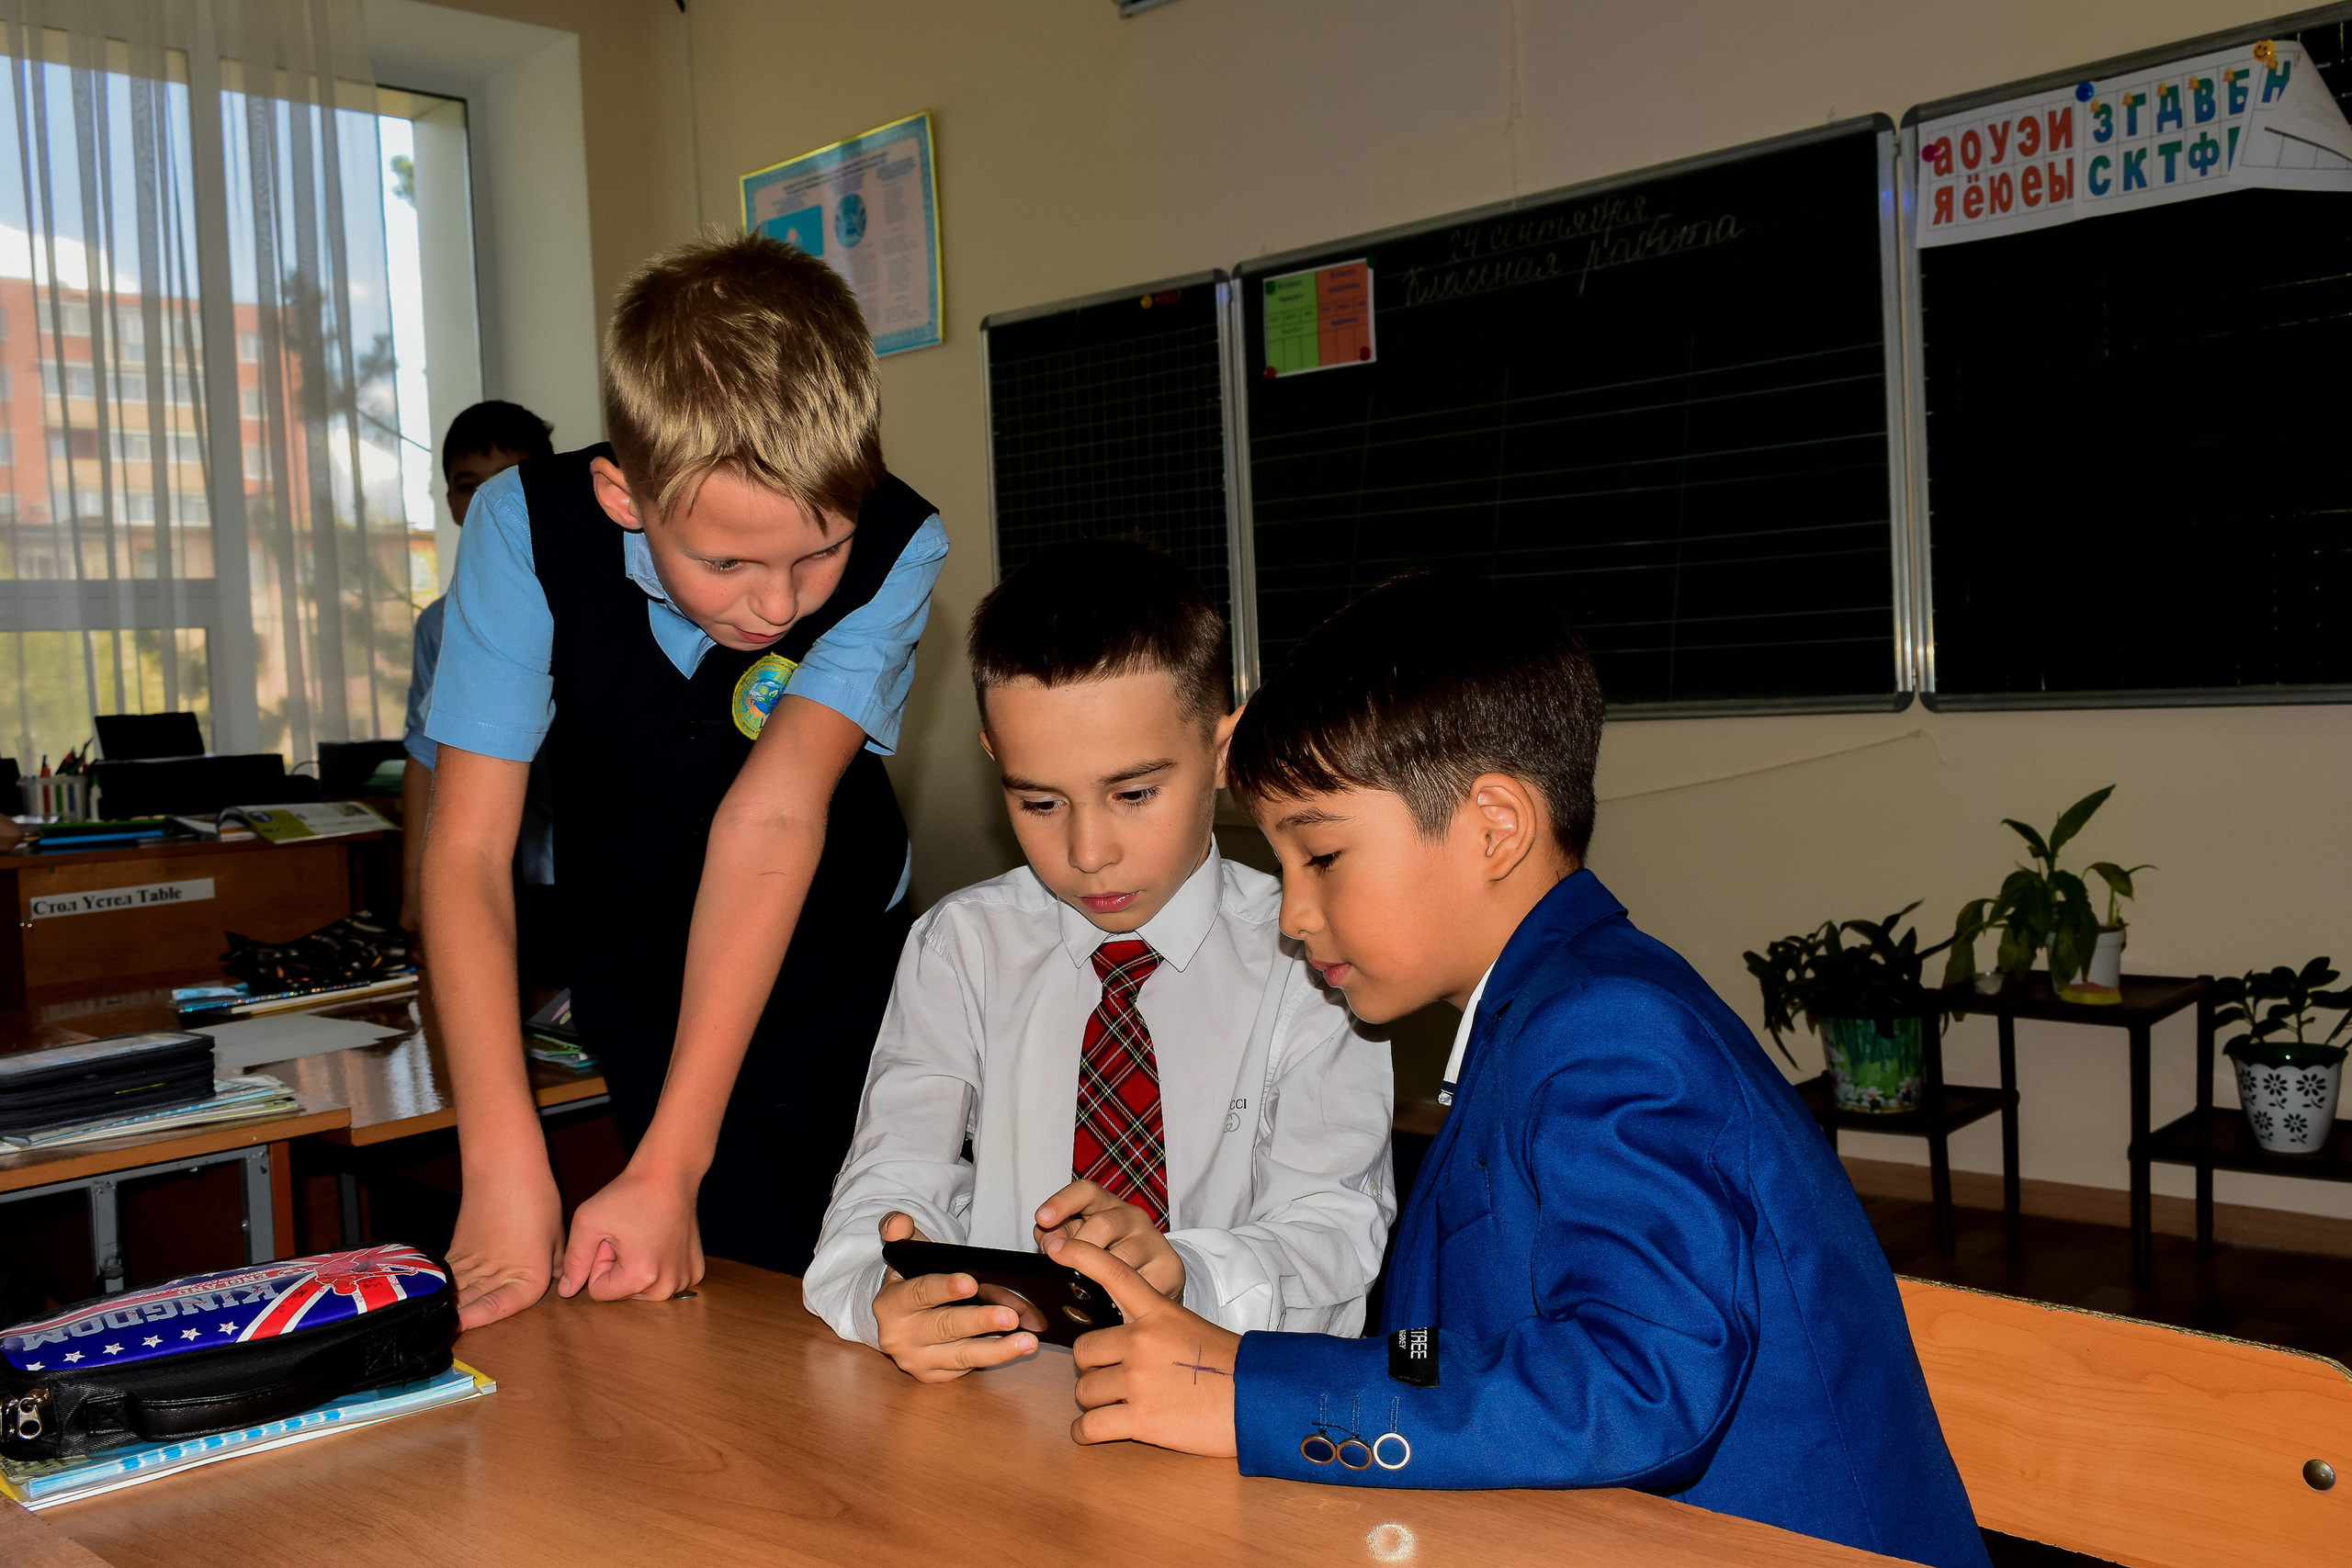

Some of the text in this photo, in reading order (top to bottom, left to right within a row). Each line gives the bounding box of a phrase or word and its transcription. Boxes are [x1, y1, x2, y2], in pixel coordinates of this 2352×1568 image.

[1402, 212, 1747, 307] Классная работа
[1448, 228, 1481, 265] 24
[33, 900, 78, 916] Стол
[136, 886, 183, 903] Table
[175, 1271, 268, 1296] ENGLAND
[21, 1284, 280, 1352] KINGDOM
[1410, 1327, 1428, 1359] TREE
